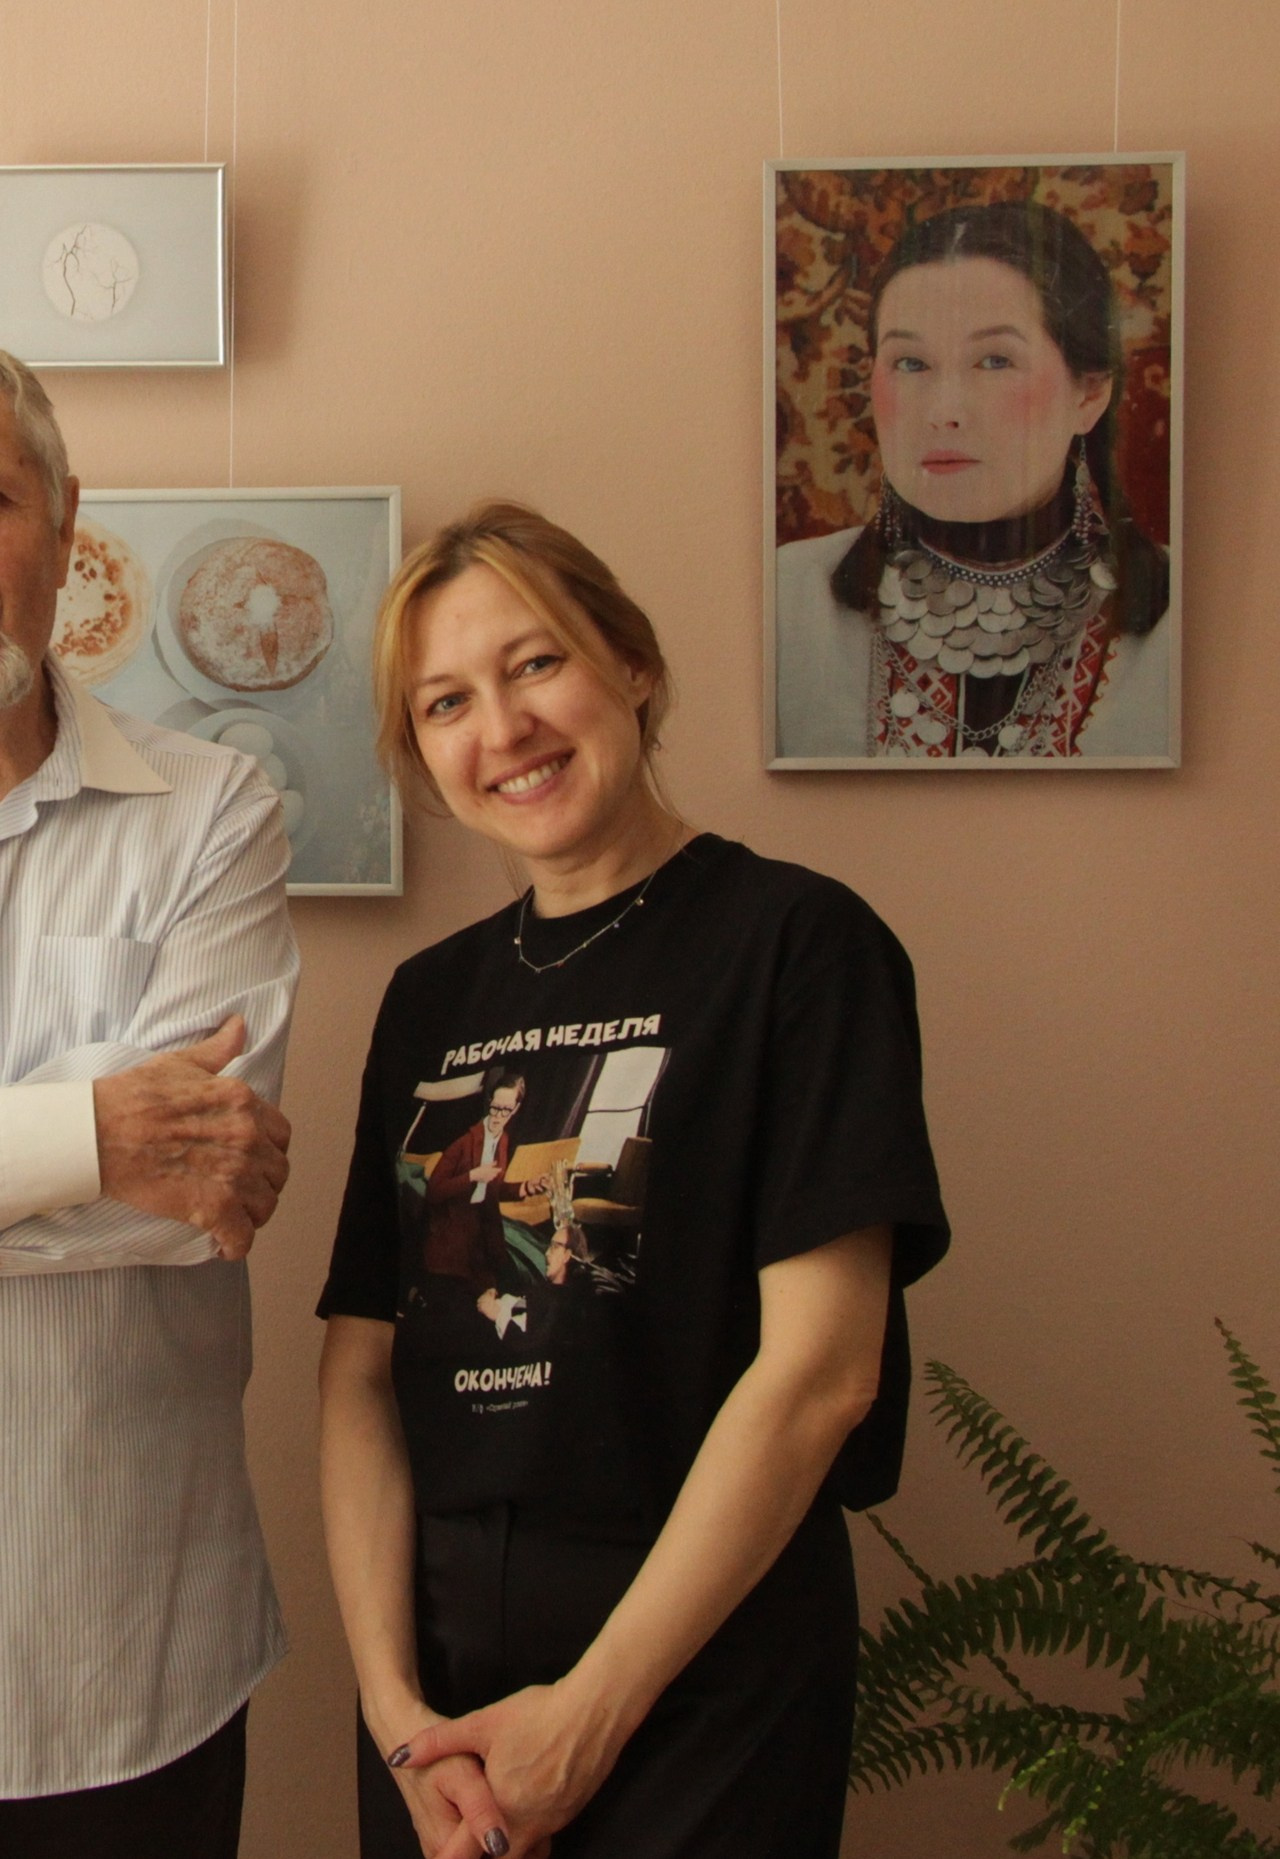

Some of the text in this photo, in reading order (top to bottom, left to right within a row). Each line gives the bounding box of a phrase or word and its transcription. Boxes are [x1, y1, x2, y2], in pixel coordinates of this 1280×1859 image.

[440, 1013, 661, 1076] РАБОЧАЯ НЕДЕЛЯ
[454, 1361, 552, 1393] ОКОНЧЕНА!
